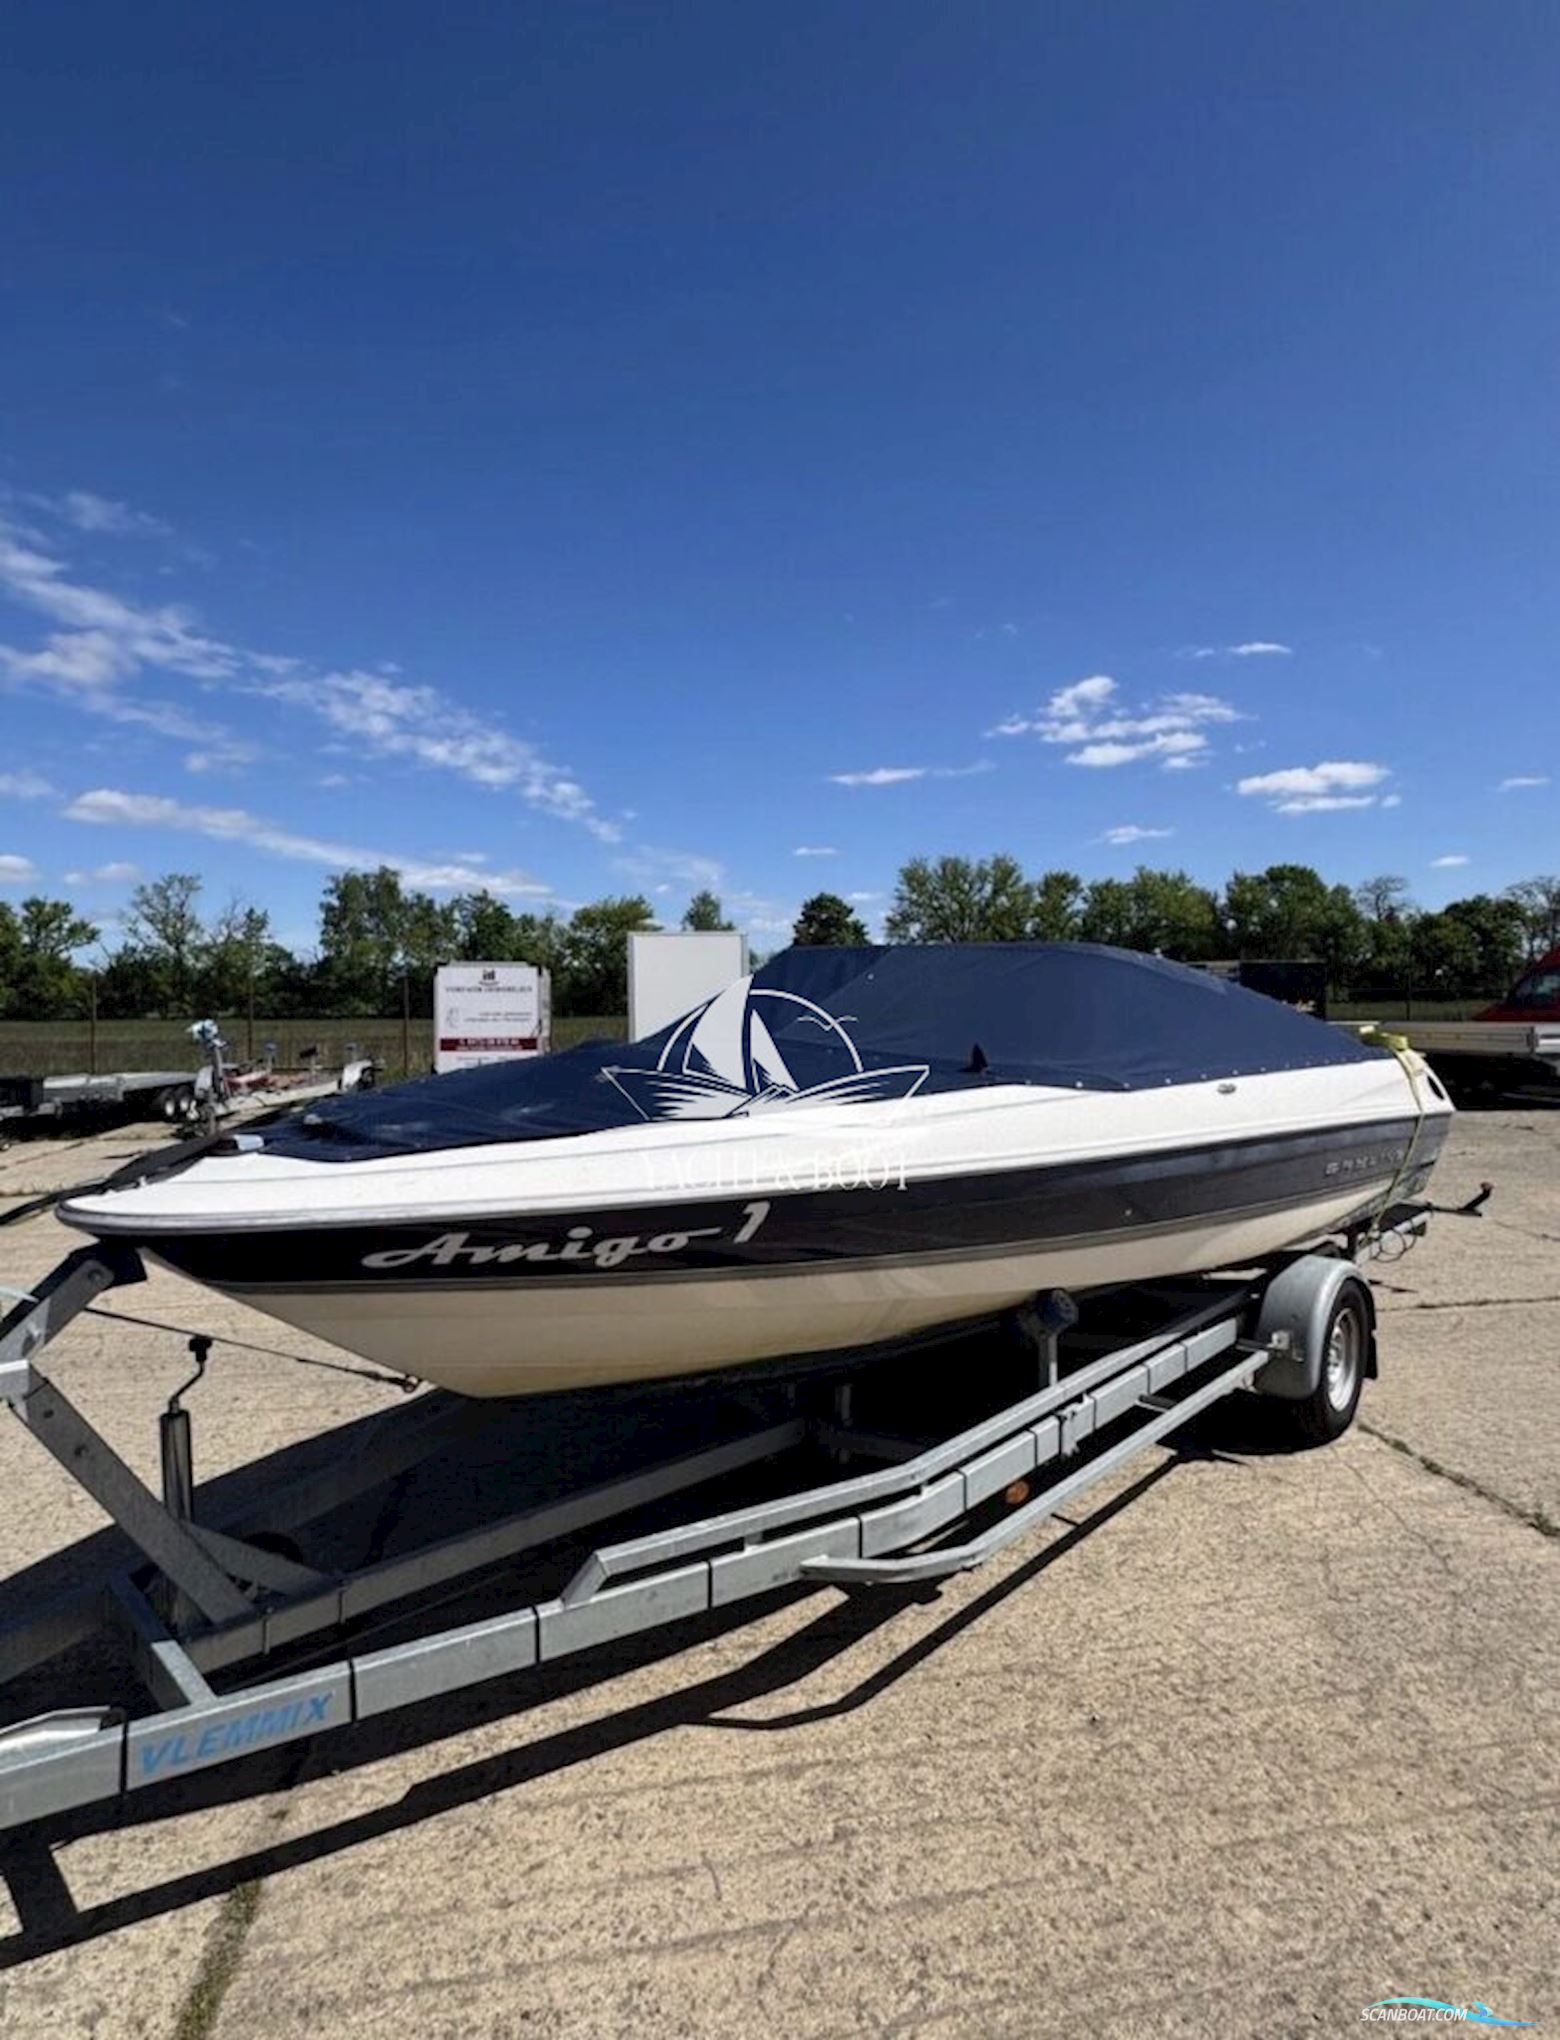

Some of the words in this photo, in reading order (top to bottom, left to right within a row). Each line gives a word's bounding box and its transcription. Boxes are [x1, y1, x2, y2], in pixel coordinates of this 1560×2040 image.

[361, 1226, 721, 1268] Amigo
[732, 1201, 771, 1244] 1
[140, 1692, 334, 1776] VLEMMIX
